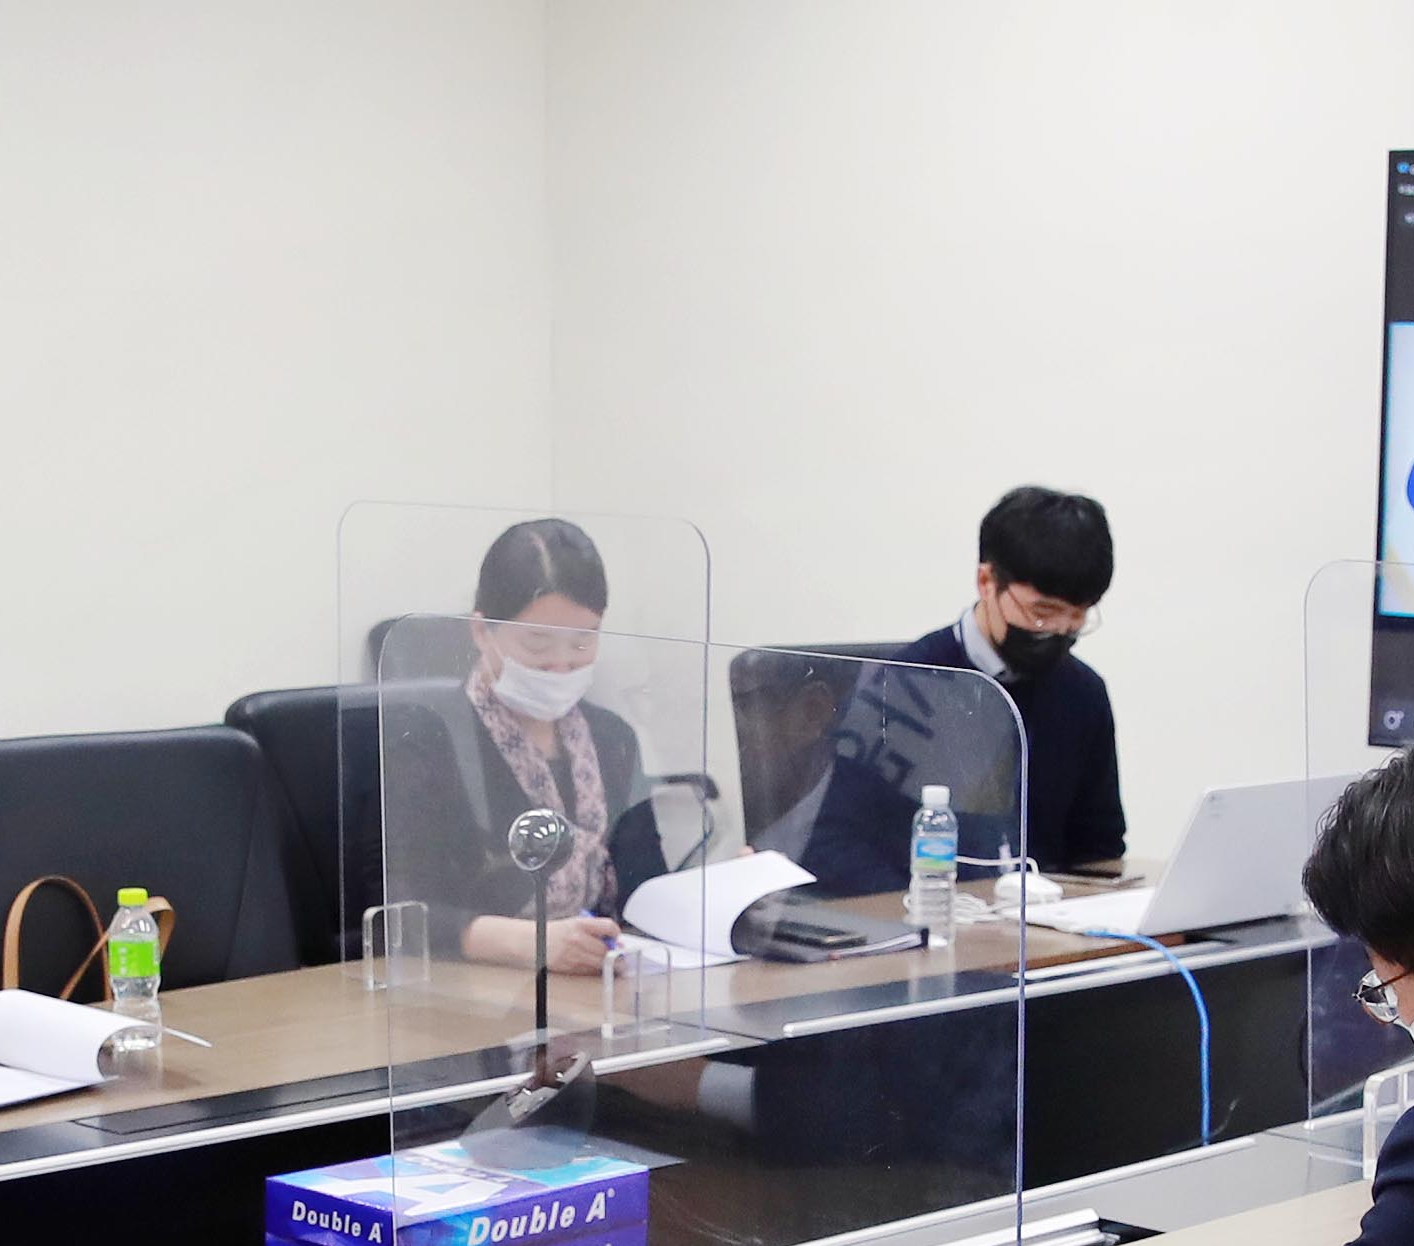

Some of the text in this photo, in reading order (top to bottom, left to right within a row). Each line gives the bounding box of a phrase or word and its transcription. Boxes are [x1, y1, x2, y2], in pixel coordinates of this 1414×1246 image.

[292, 1200, 382, 1244] Double A
[467, 1201, 576, 1246] Double
